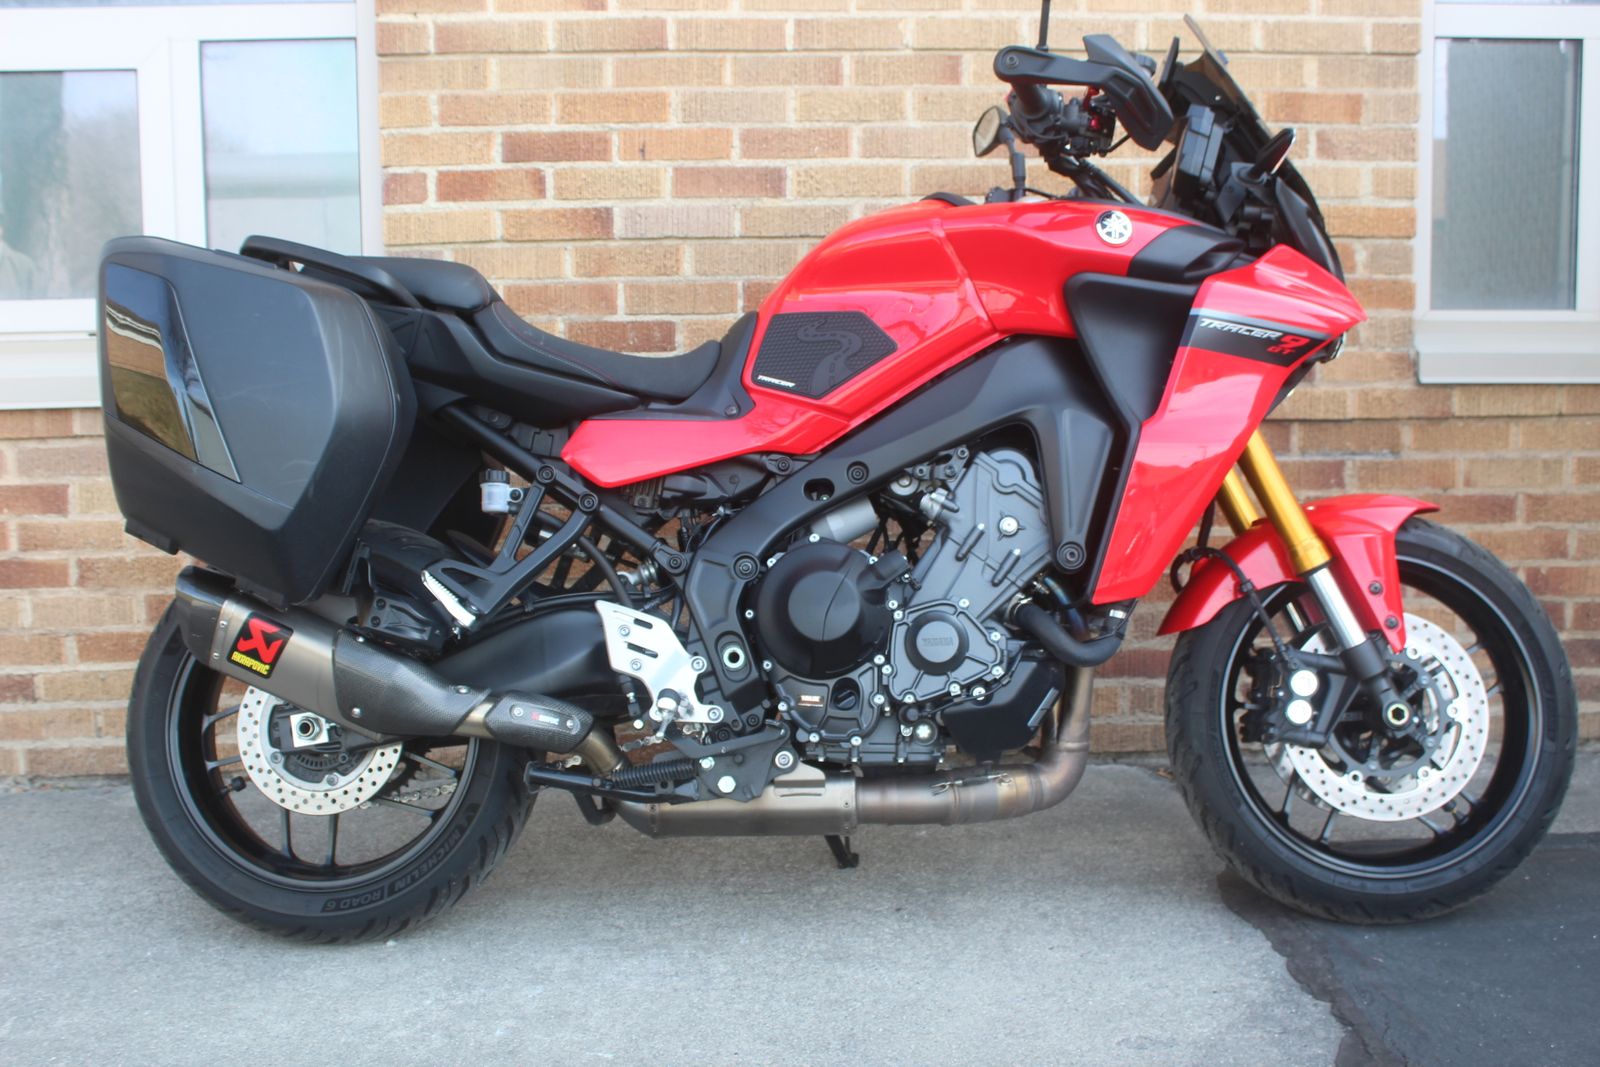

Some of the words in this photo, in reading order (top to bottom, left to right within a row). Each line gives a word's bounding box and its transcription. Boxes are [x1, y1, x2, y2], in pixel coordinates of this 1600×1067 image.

[1200, 318, 1283, 341] TRACER
[394, 828, 462, 892] MICHELIN
[340, 891, 381, 911] ROAD
